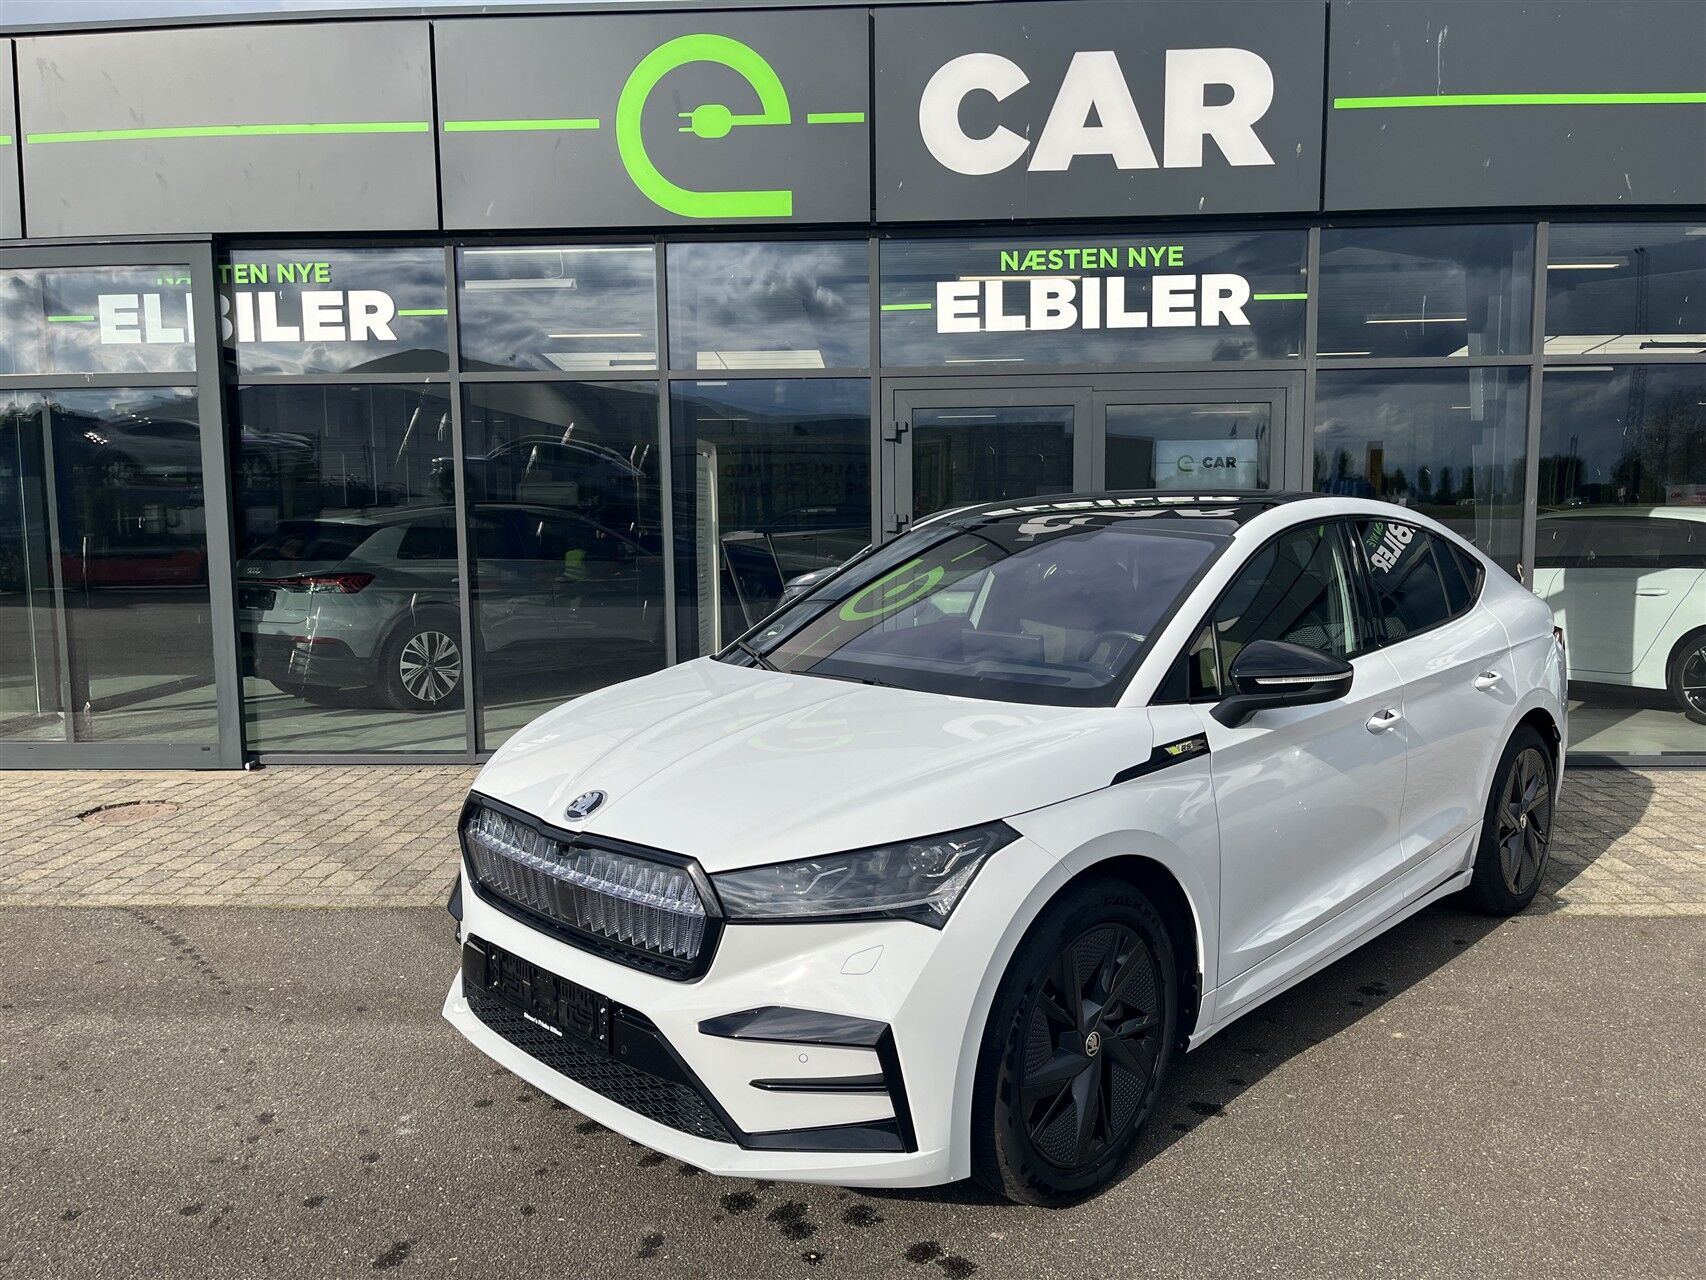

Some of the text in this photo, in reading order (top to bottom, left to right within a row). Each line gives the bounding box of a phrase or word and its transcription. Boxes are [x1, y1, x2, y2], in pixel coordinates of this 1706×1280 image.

[919, 48, 1275, 175] CAR
[1000, 246, 1184, 271] NÆSTEN NYE
[156, 262, 331, 285] NTEN NYE
[936, 273, 1251, 334] ELBILER
[1202, 456, 1237, 469] CAR
